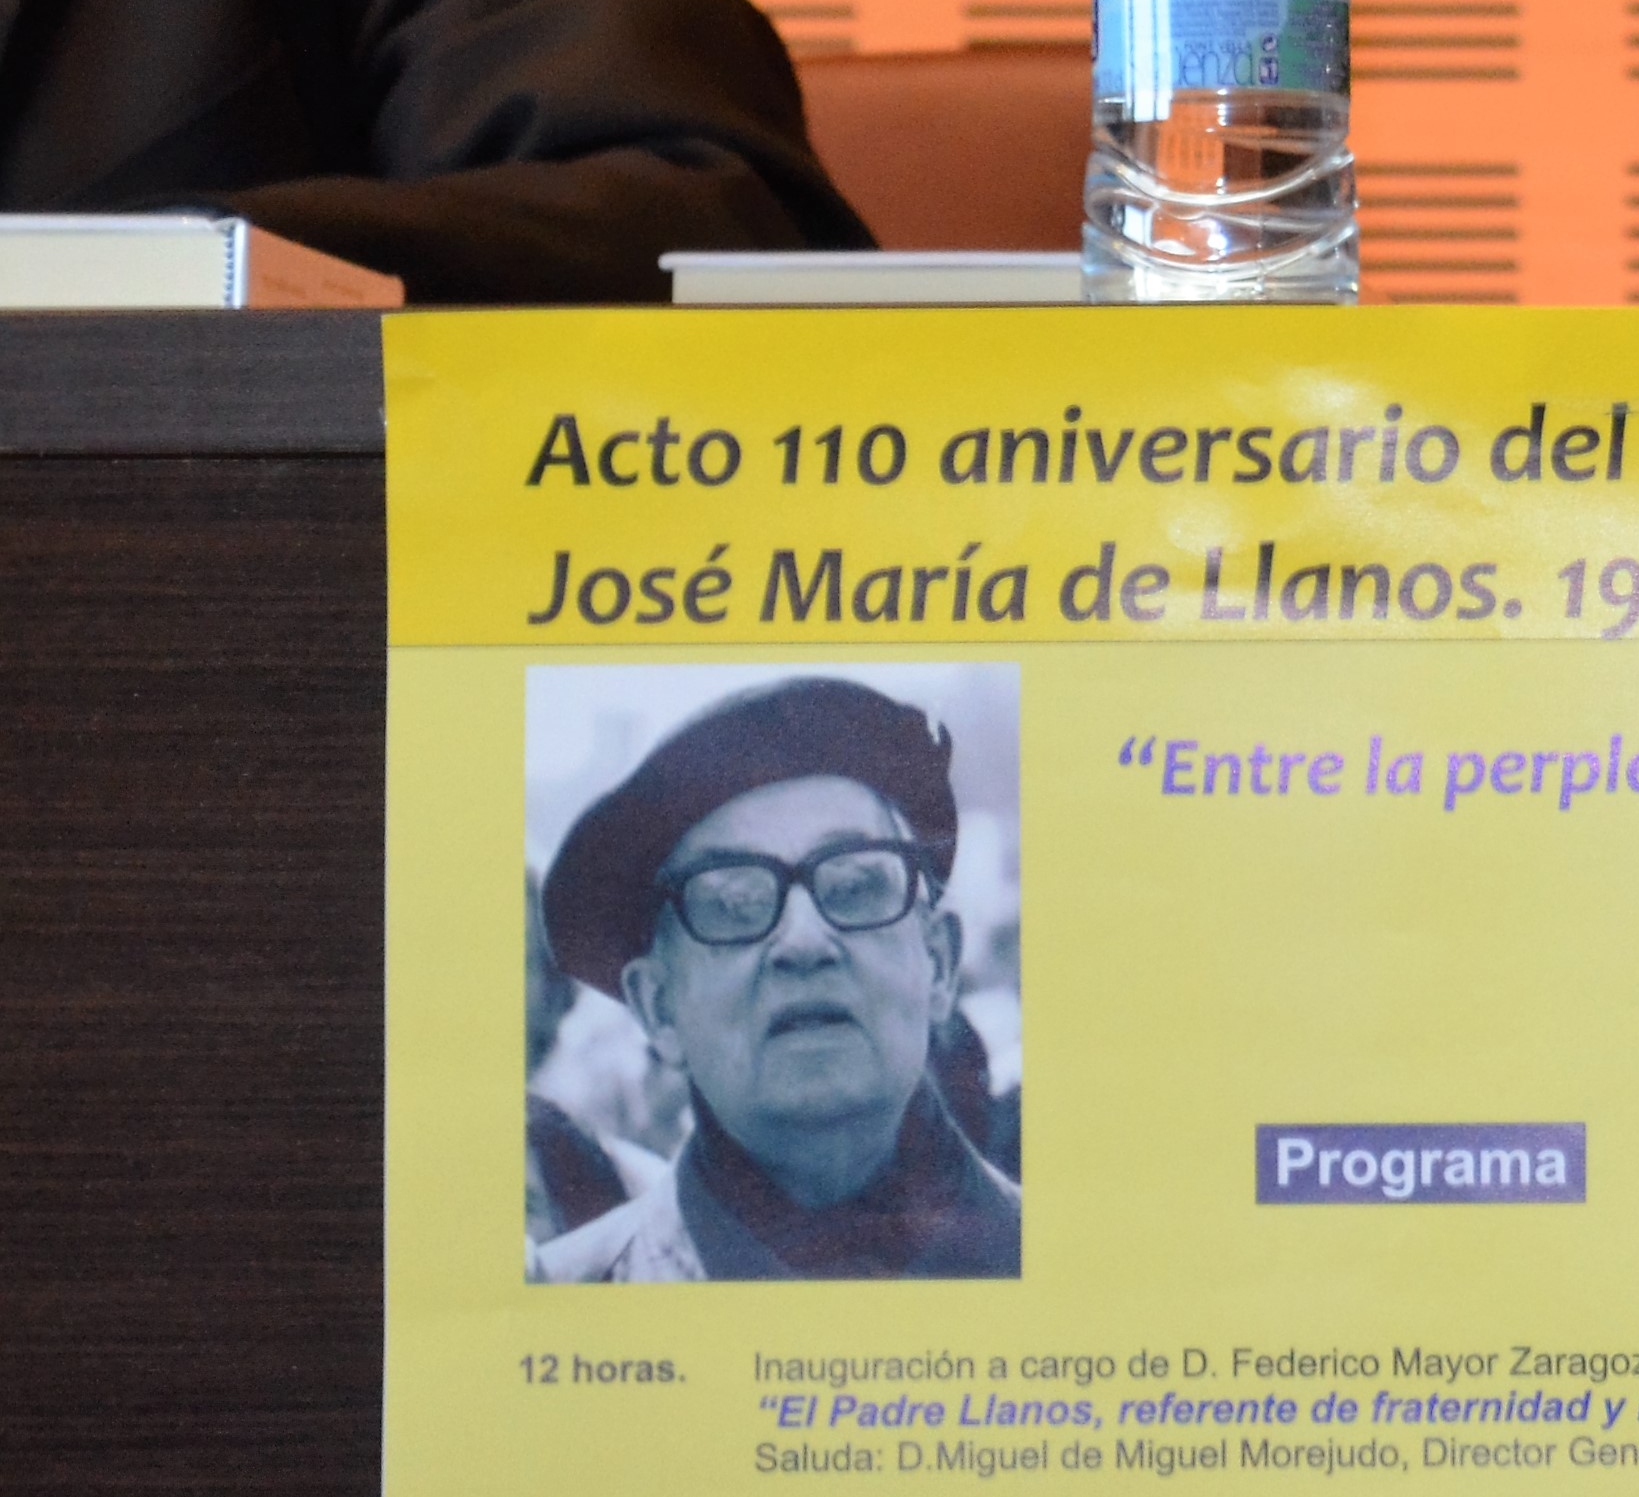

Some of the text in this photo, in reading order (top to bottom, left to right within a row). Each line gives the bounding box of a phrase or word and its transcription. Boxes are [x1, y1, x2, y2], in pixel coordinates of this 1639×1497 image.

[526, 415, 741, 487] Acto
[775, 424, 907, 485] 110
[940, 404, 1459, 485] aniversario
[1491, 403, 1629, 481] del
[528, 544, 732, 625] José
[760, 543, 1028, 623] María
[1059, 541, 1170, 622] de
[1201, 541, 1521, 620] Llanos.
[1366, 735, 1423, 795] la
[1275, 1134, 1568, 1198] Programa
[520, 1354, 559, 1384] 12
[573, 1354, 685, 1384] horas.
[754, 1350, 975, 1389] Inauguración
[988, 1356, 1008, 1379] a
[1020, 1355, 1116, 1387] cargo
[1127, 1349, 1170, 1378] de
[1183, 1348, 1217, 1378] D.
[1232, 1347, 1380, 1378] Federico
[1393, 1347, 1499, 1384] Mayor
[830, 1395, 945, 1427] Padre
[959, 1394, 1102, 1432] Llanos,
[1120, 1391, 1297, 1424] referente
[1311, 1391, 1358, 1423] de
[1373, 1390, 1592, 1423] fraternidad
[1602, 1399, 1628, 1430] y
[755, 1442, 881, 1474] Saluda:
[898, 1441, 1048, 1479] D.Miguel
[1061, 1441, 1103, 1470] de
[1116, 1439, 1227, 1477] Miguel
[1240, 1438, 1408, 1476] Morejudo,
[1423, 1437, 1557, 1468] Director
